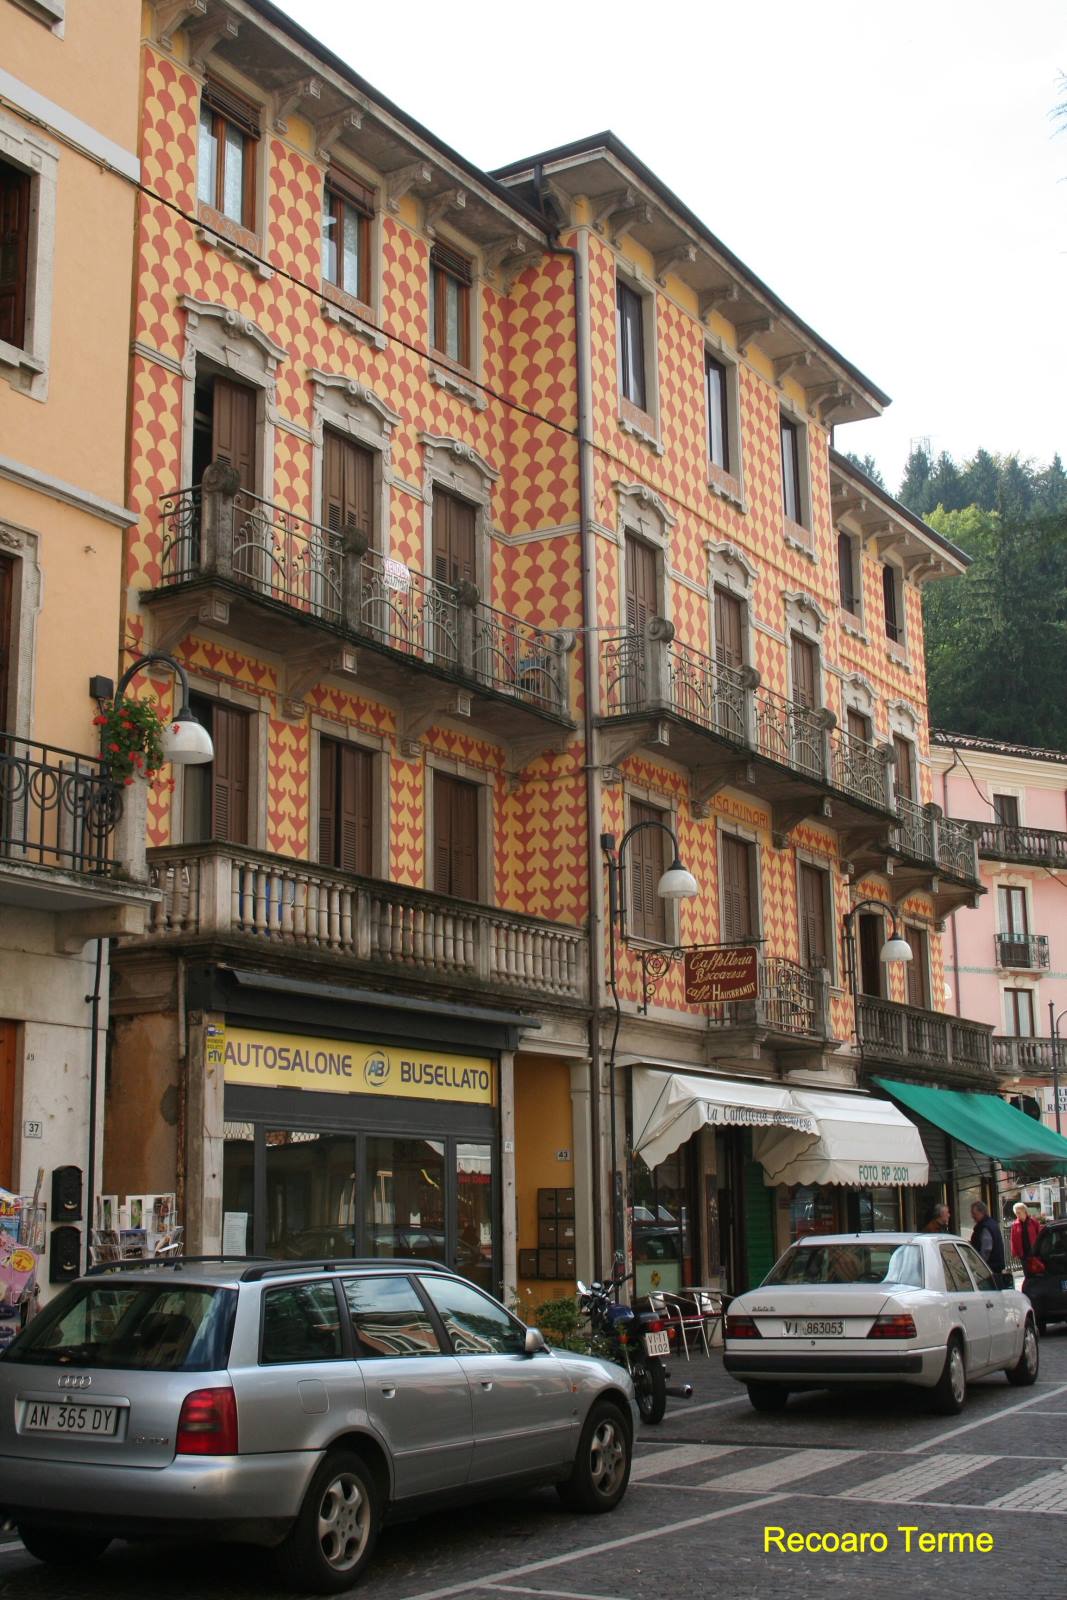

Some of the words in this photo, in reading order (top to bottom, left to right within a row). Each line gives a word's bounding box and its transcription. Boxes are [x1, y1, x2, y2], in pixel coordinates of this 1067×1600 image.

[712, 982, 756, 1001] HAUSBRANDT
[224, 1041, 352, 1077] AUTOSALONE
[400, 1061, 489, 1090] BUSELLATO
[706, 1103, 718, 1121] La
[28, 1123, 39, 1133] 37
[558, 1151, 568, 1159] 43
[858, 1165, 878, 1180] FOTO
[893, 1166, 909, 1181] 2001
[806, 1321, 844, 1335] 863053
[30, 1405, 50, 1427] AN
[57, 1406, 88, 1429] 365
[92, 1409, 112, 1431] DY
